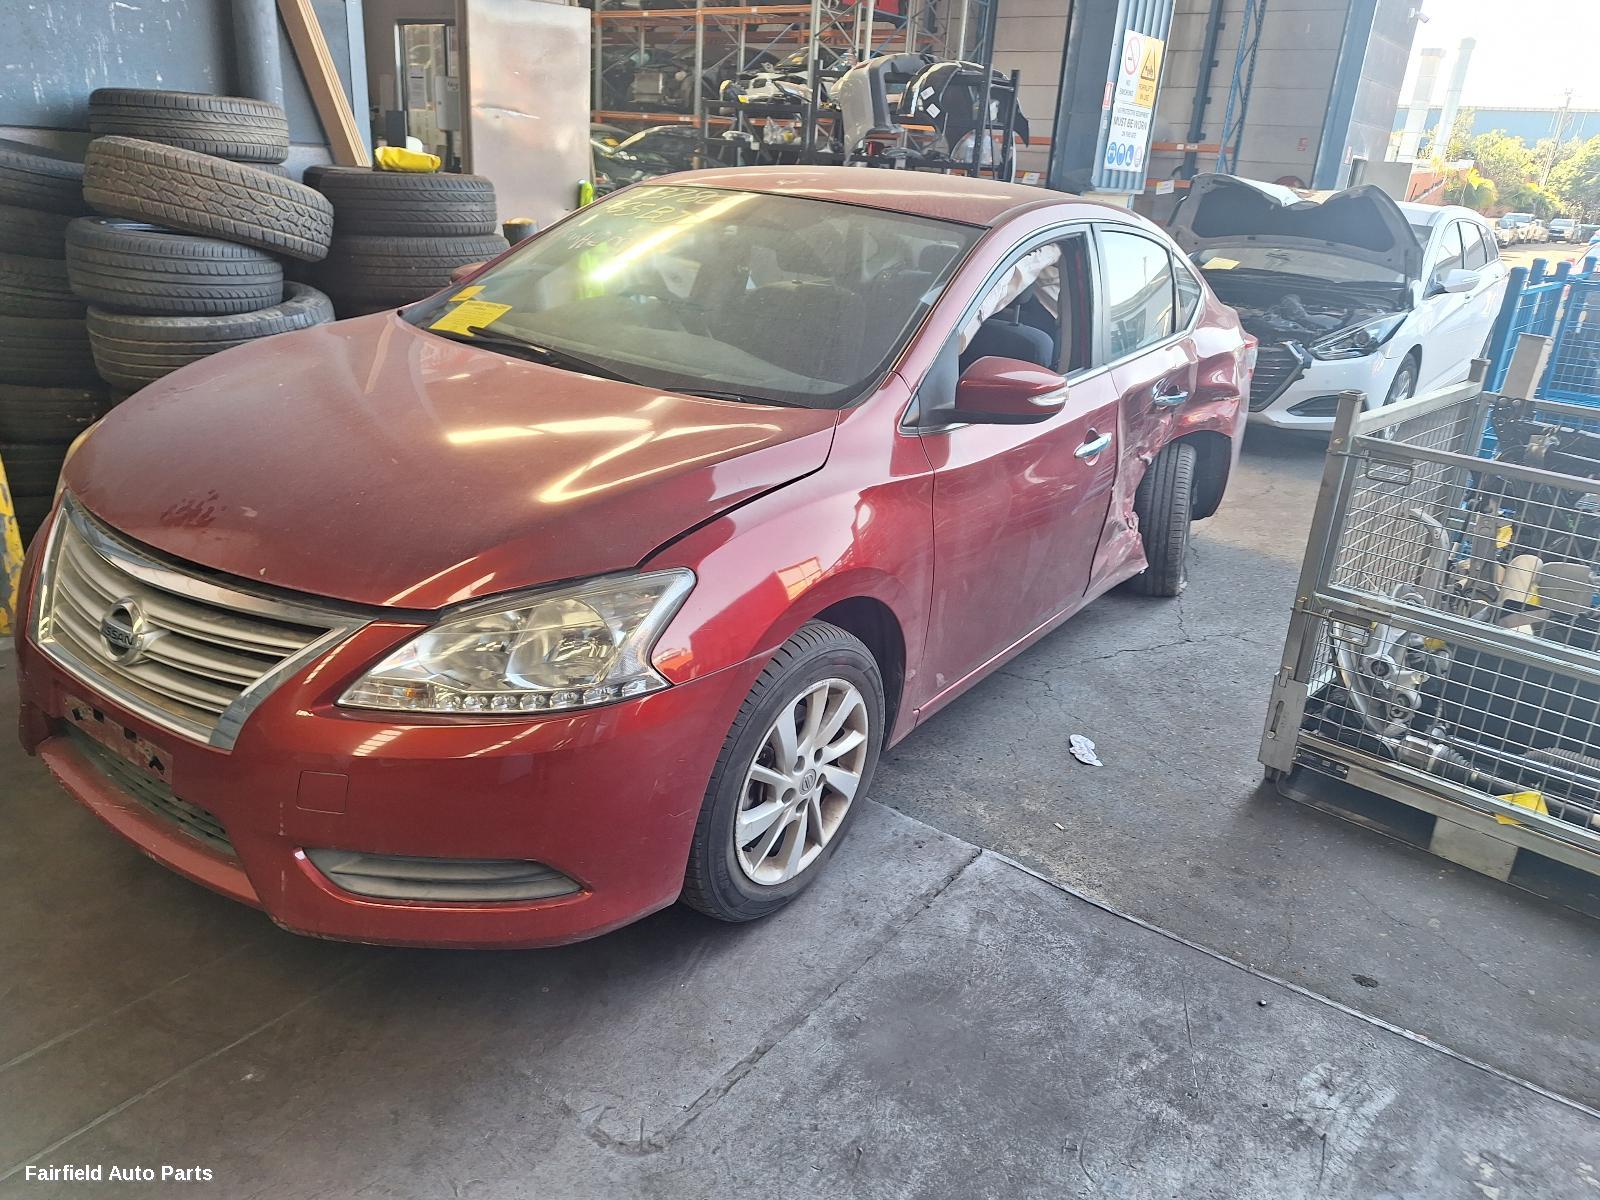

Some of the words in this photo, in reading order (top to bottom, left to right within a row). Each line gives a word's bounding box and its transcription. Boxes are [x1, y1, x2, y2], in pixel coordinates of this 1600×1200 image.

[1113, 116, 1127, 127] MUST
[1126, 118, 1134, 128] BE
[1133, 119, 1147, 130] WORN
[102, 623, 134, 646] SSAN
